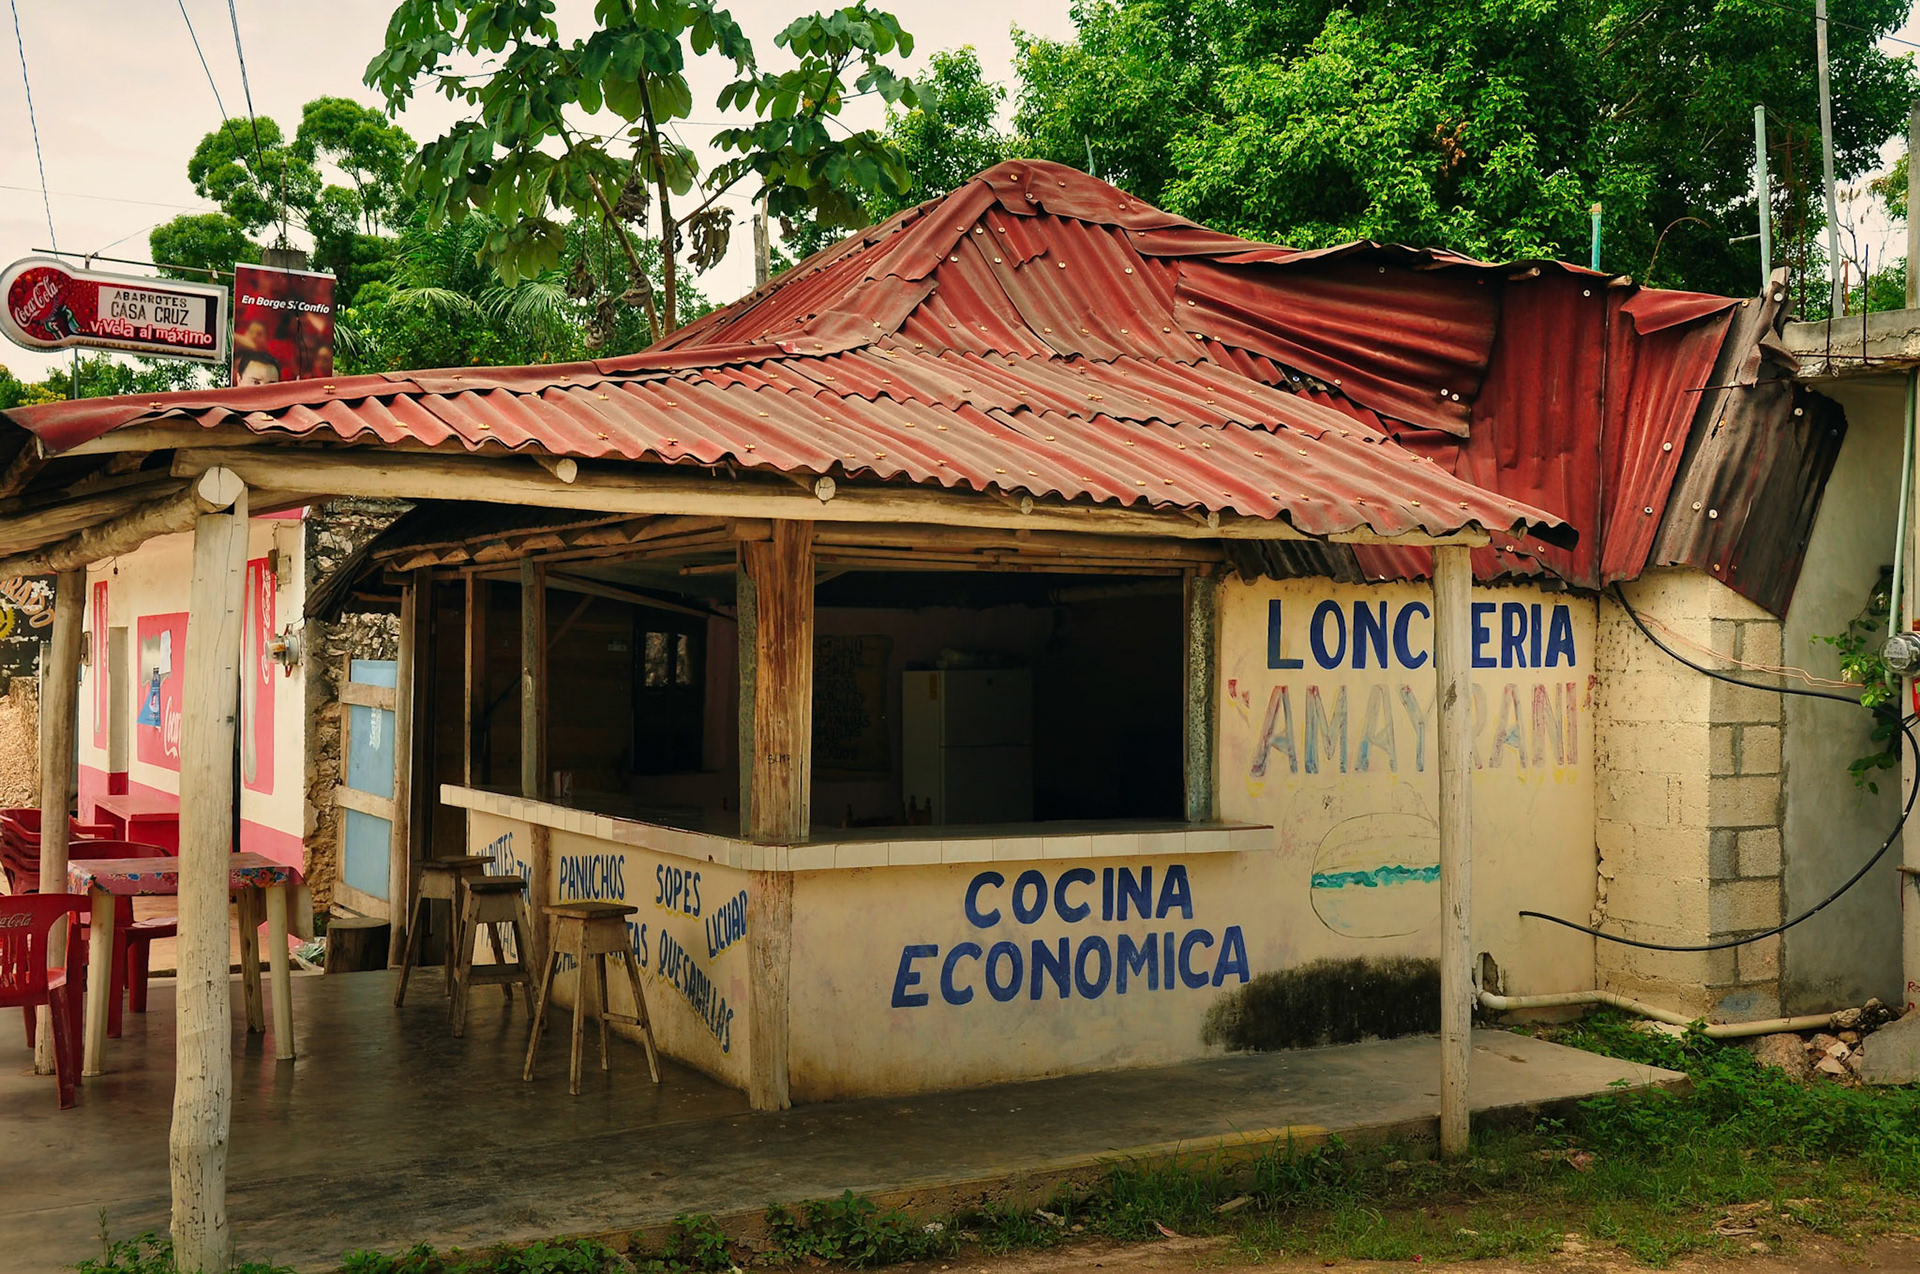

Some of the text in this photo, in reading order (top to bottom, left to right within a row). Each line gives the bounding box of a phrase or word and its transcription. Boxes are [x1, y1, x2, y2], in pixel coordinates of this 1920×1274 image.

[14, 275, 58, 328] Coca-Cola
[111, 301, 189, 326] CASA CRUZ
[114, 291, 187, 308] ABARROTES
[242, 295, 255, 304] En
[256, 296, 286, 309] Borge
[139, 324, 152, 340] al
[1267, 599, 1576, 670] LONCERIA
[559, 854, 625, 900] PANUCHOS
[655, 863, 701, 917] SOPES
[964, 864, 1194, 929] COCINA
[890, 925, 1251, 1009] ECONOMICA
